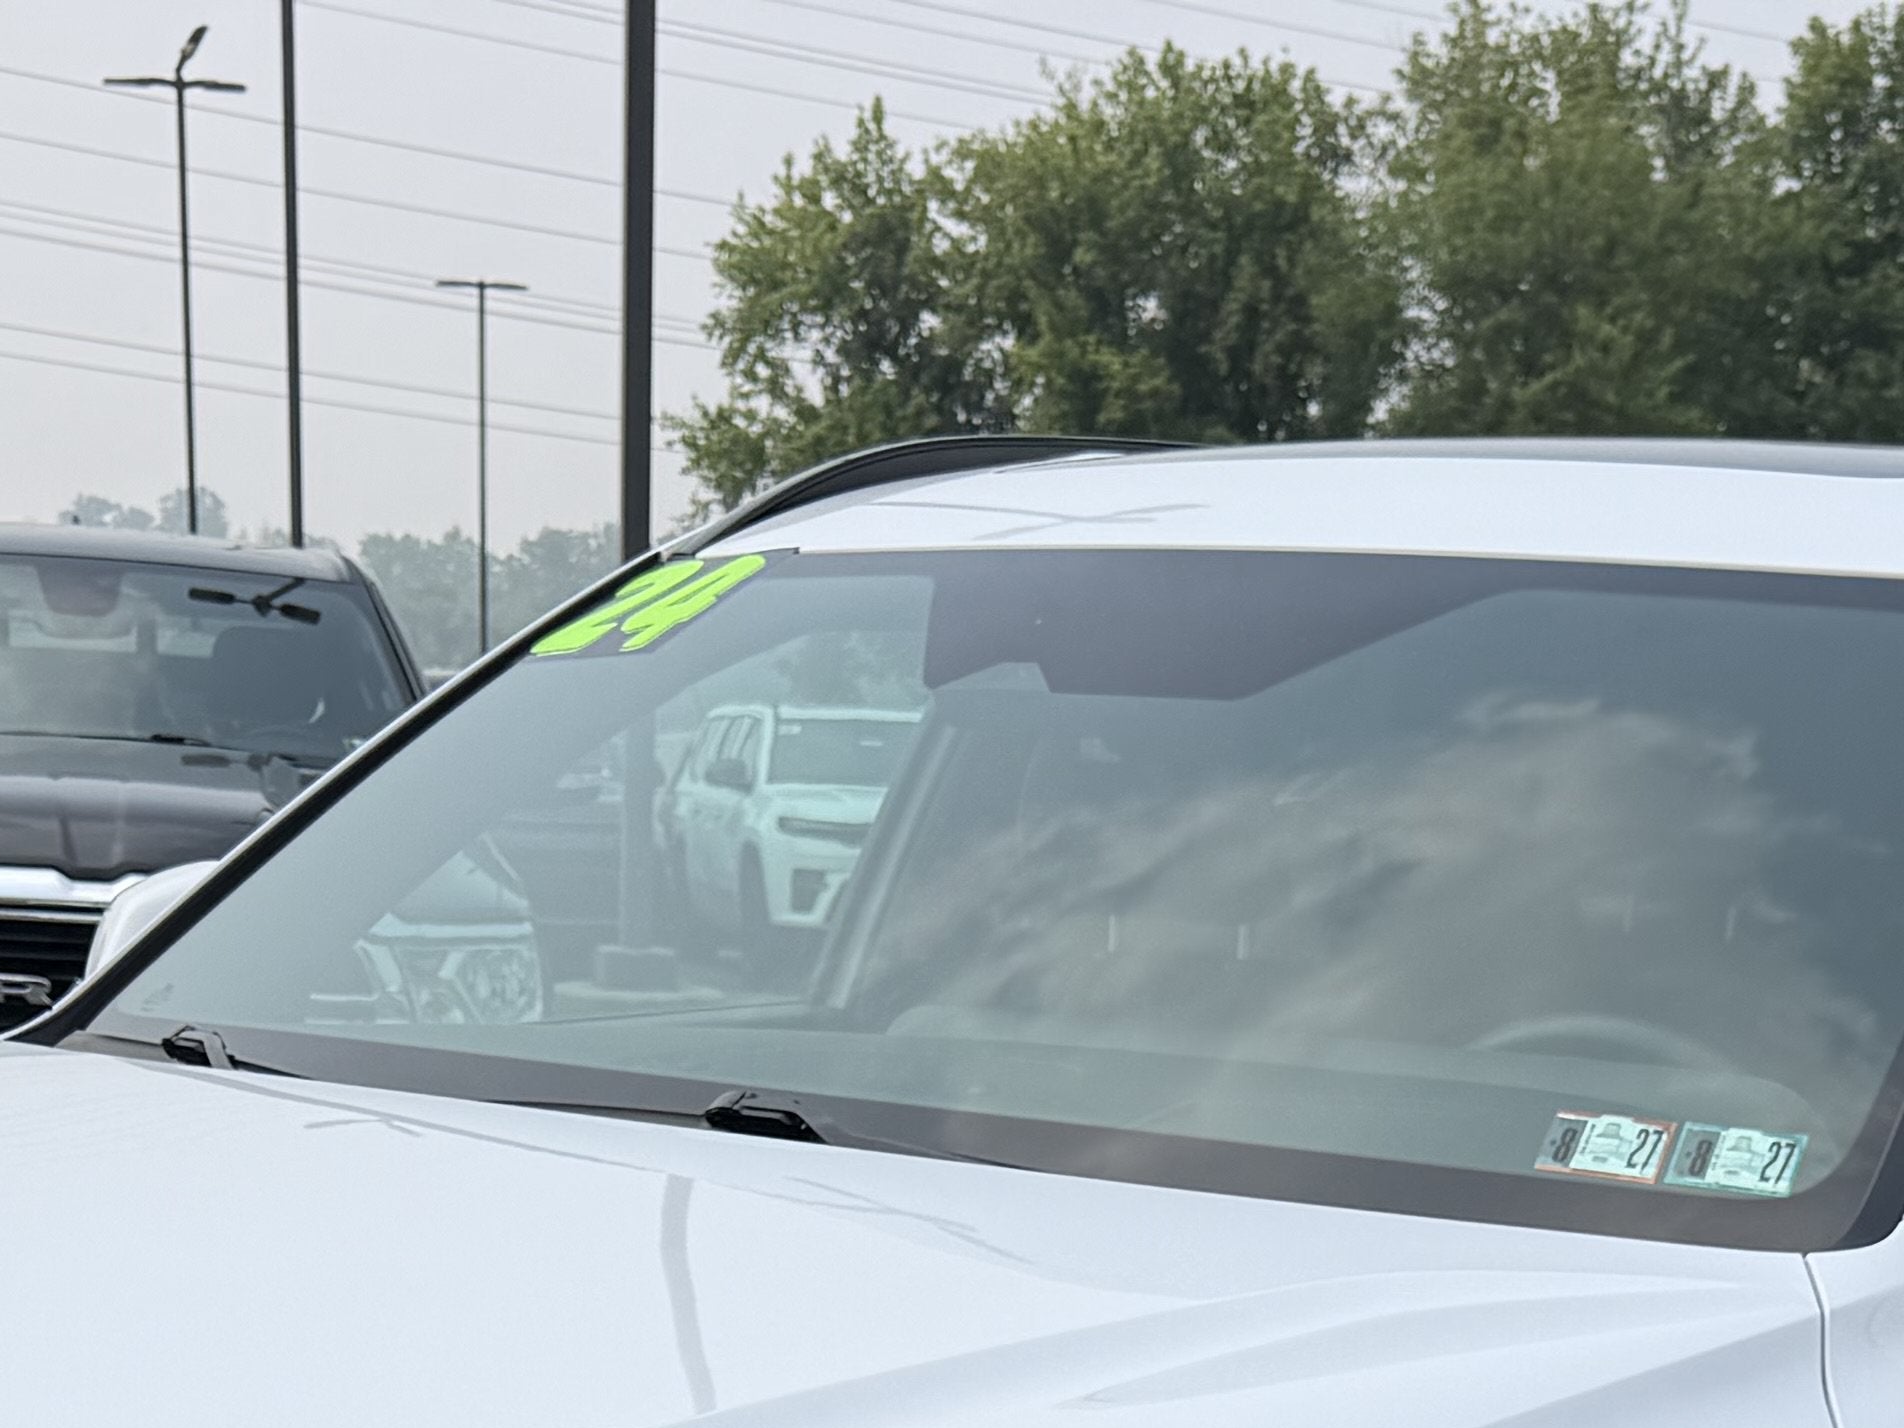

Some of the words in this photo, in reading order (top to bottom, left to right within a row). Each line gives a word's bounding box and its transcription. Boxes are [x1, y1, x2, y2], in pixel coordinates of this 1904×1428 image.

[529, 554, 767, 657] 24
[1552, 1127, 1578, 1163] 8
[1625, 1128, 1665, 1175] 27
[1688, 1139, 1713, 1177] 8
[1758, 1141, 1797, 1187] 27
